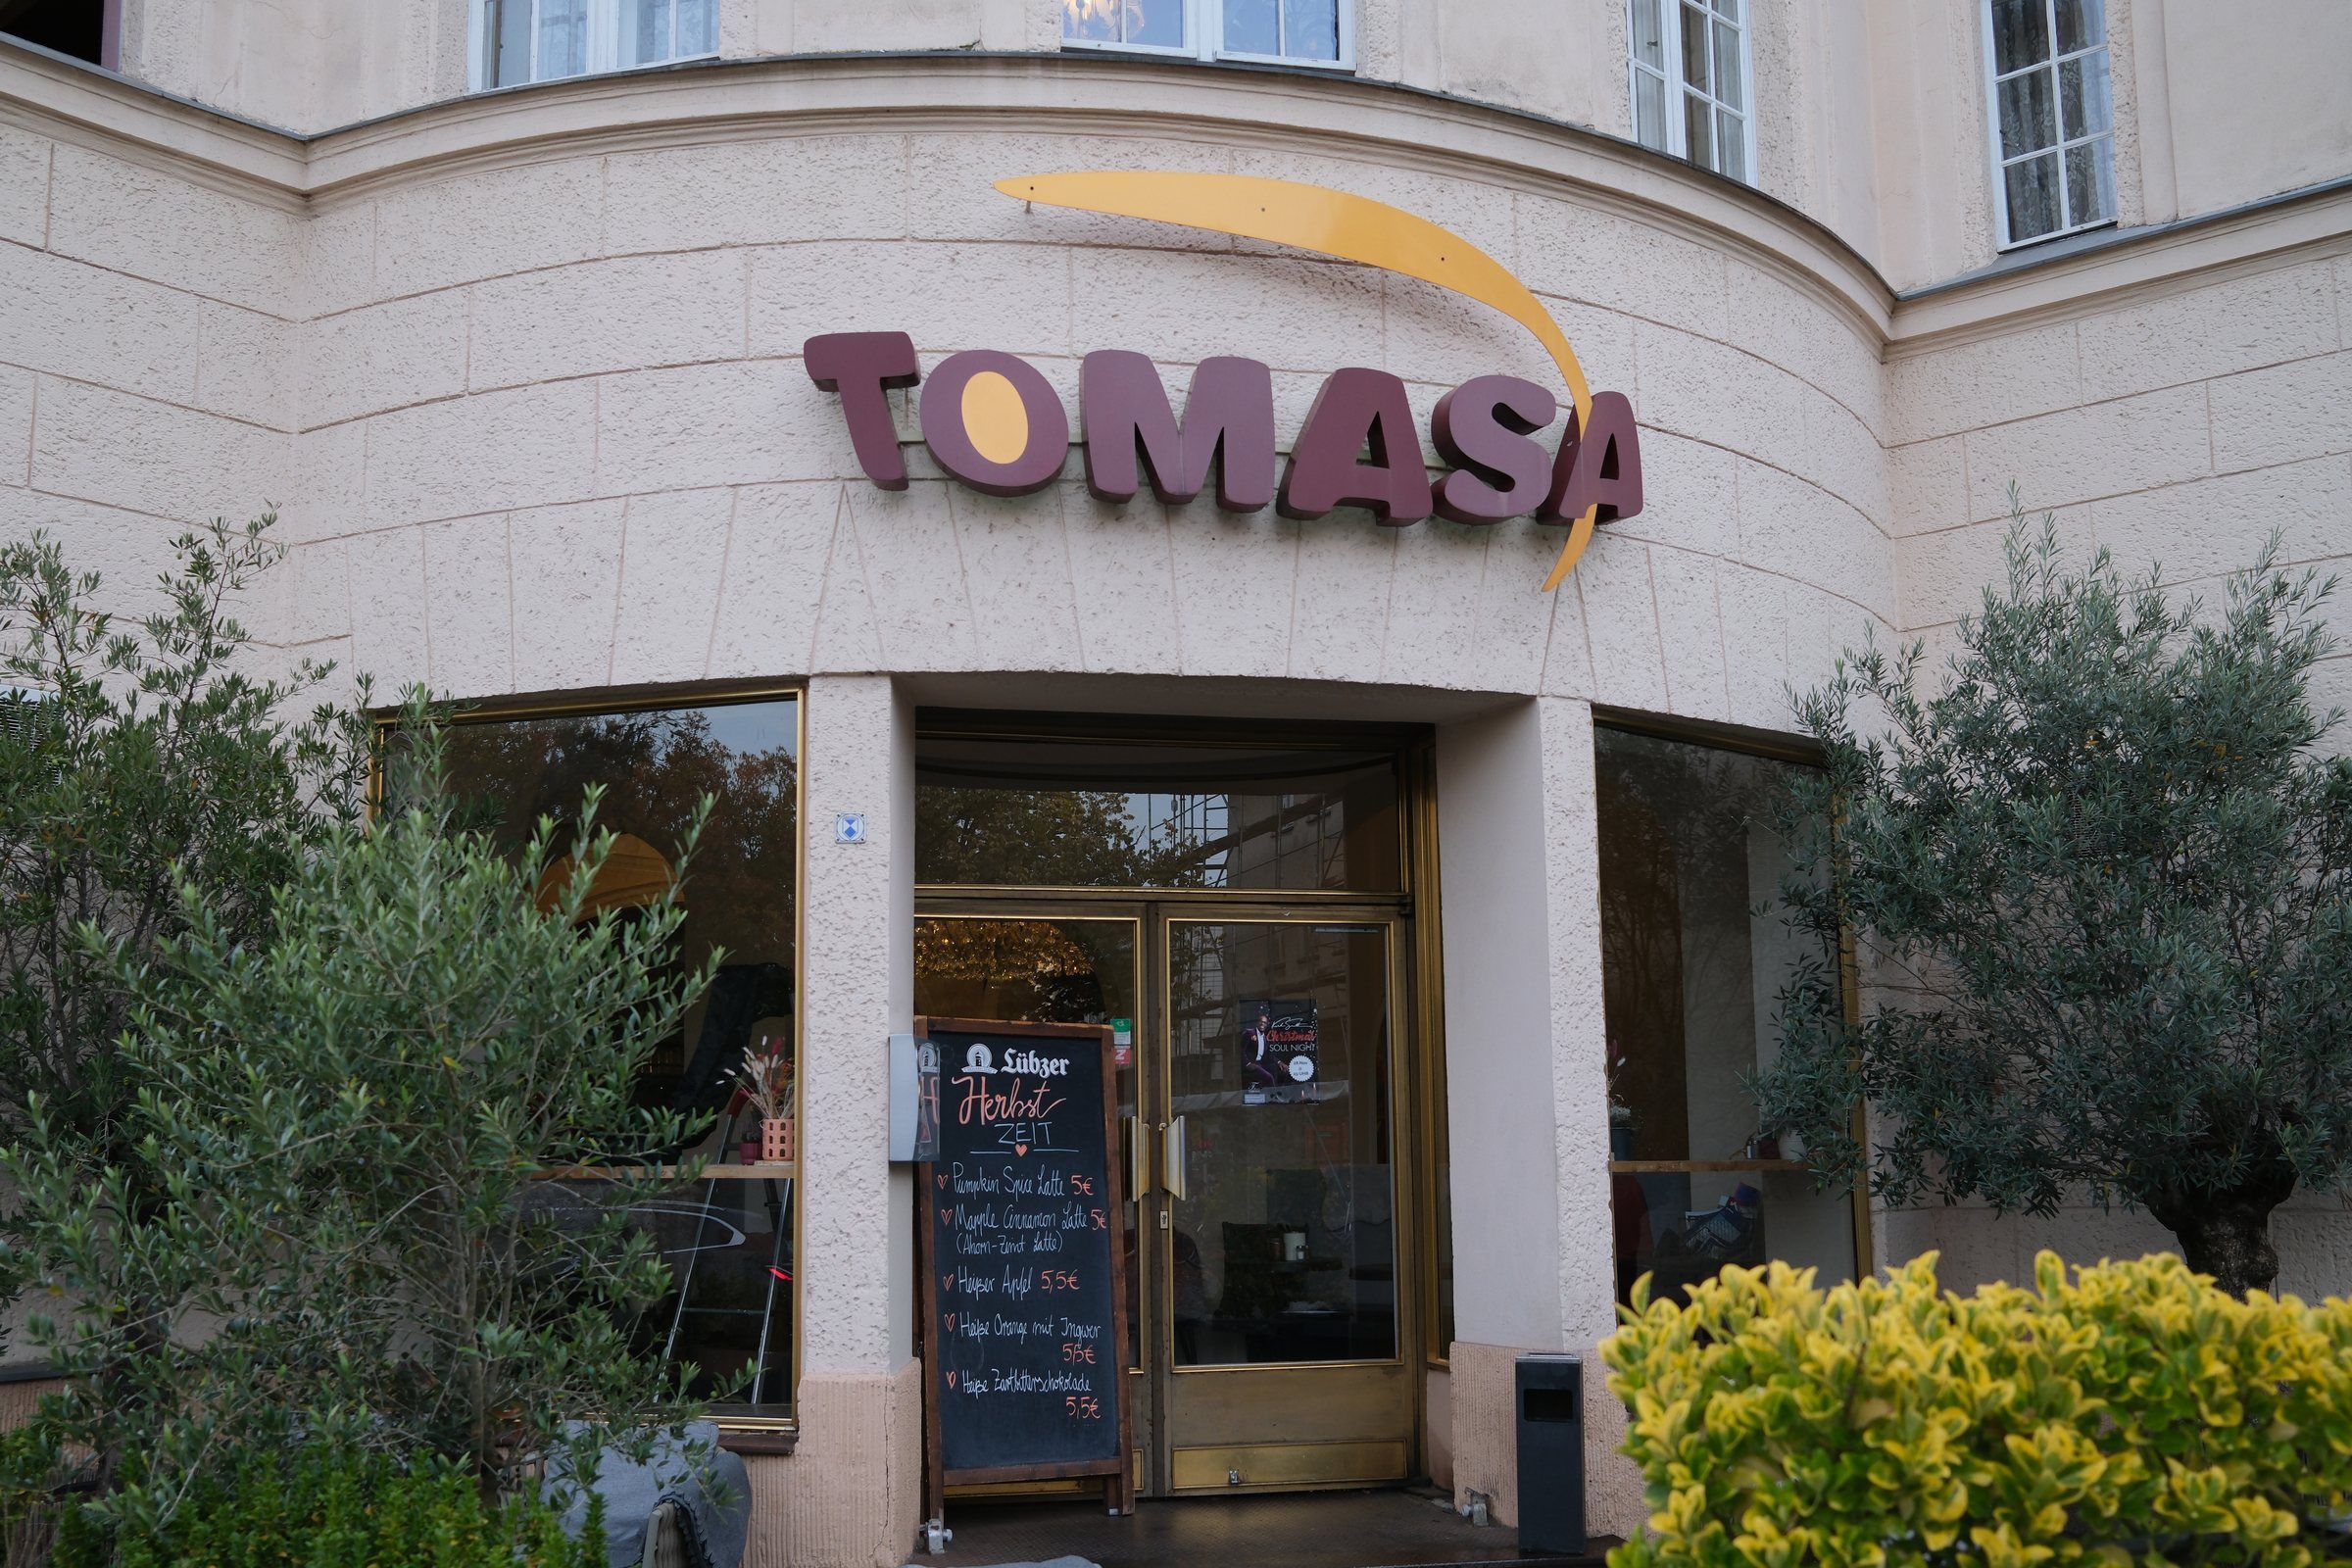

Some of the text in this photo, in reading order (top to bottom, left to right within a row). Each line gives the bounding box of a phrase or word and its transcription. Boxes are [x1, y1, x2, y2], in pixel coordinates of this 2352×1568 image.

[804, 331, 1643, 527] TOMASA
[1001, 1048, 1069, 1078] Lübzer
[951, 1076, 1066, 1125] Herbst
[994, 1121, 1053, 1145] ZEIT
[953, 1161, 1094, 1201] Pumpkin Spice Latte 5€
[1003, 1203, 1056, 1230] Cinnamon
[1061, 1200, 1088, 1230] Latte
[1090, 1208, 1107, 1231] 5€
[957, 1265, 996, 1300] Heißer
[1002, 1263, 1033, 1300] Apfel
[959, 1311, 1102, 1346] Heiße Orange mit Ingwer
[961, 1369, 990, 1399] Heiße
